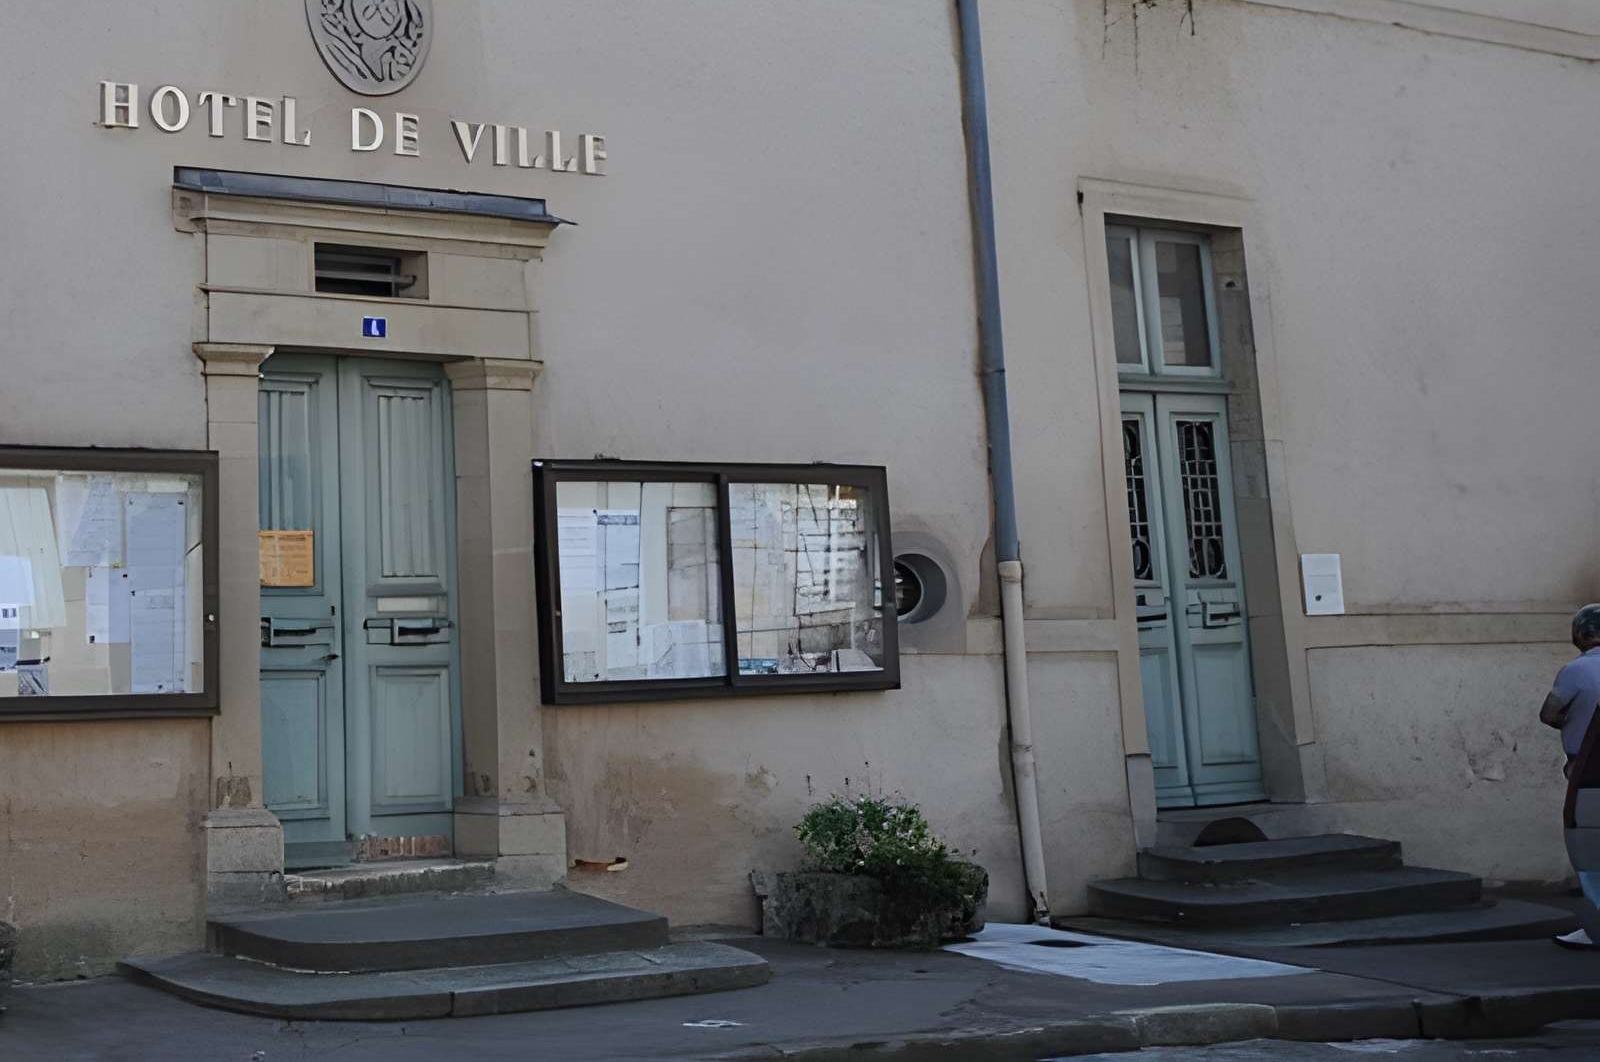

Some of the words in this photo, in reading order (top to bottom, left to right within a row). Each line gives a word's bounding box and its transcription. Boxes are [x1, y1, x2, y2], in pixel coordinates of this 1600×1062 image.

[100, 81, 312, 146] HOTEL
[352, 108, 421, 157] DE
[451, 120, 608, 176] VILLE
